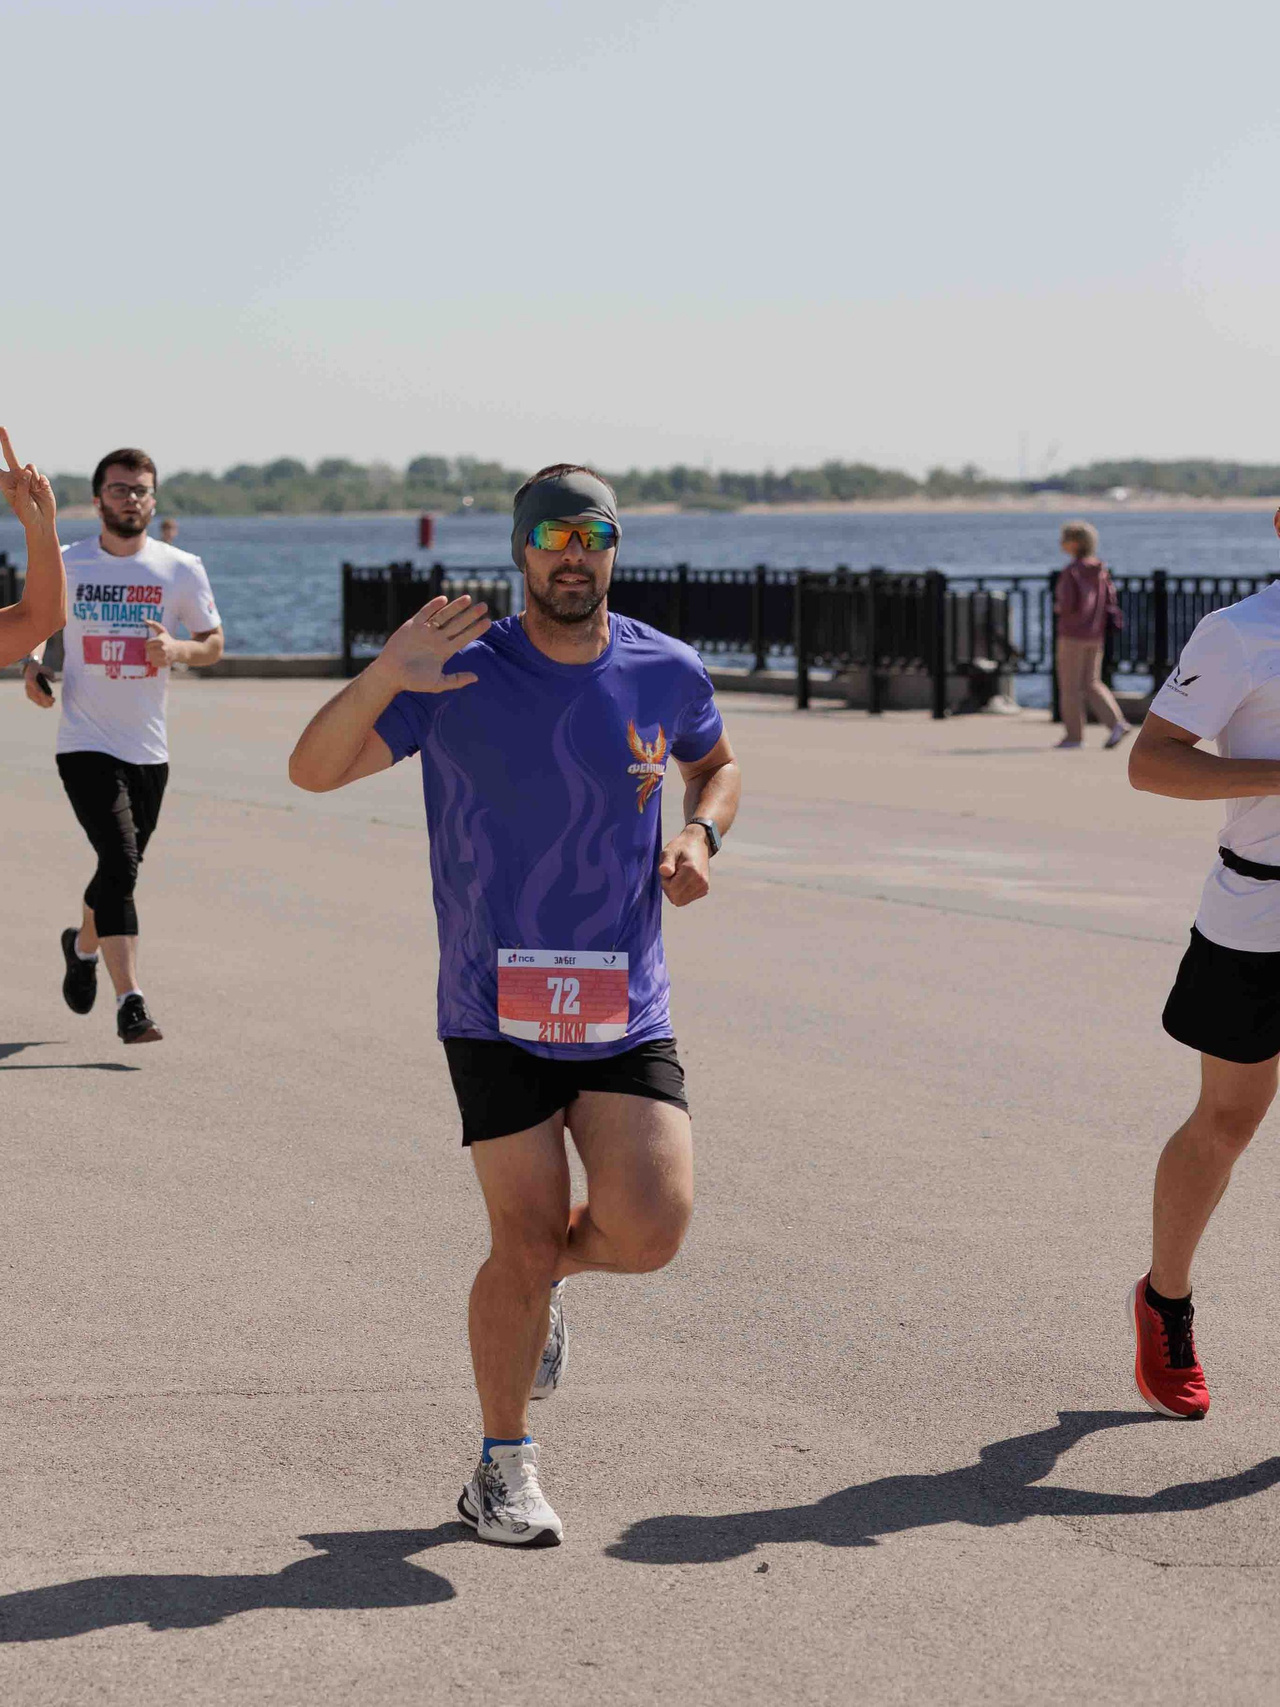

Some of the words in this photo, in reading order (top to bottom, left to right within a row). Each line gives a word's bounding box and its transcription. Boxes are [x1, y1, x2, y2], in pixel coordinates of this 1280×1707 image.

[75, 584, 163, 605] #ЗАБЕГ2025
[101, 603, 165, 624] ПЛАНЕТЫ
[101, 640, 126, 662] 617
[547, 977, 580, 1015] 72
